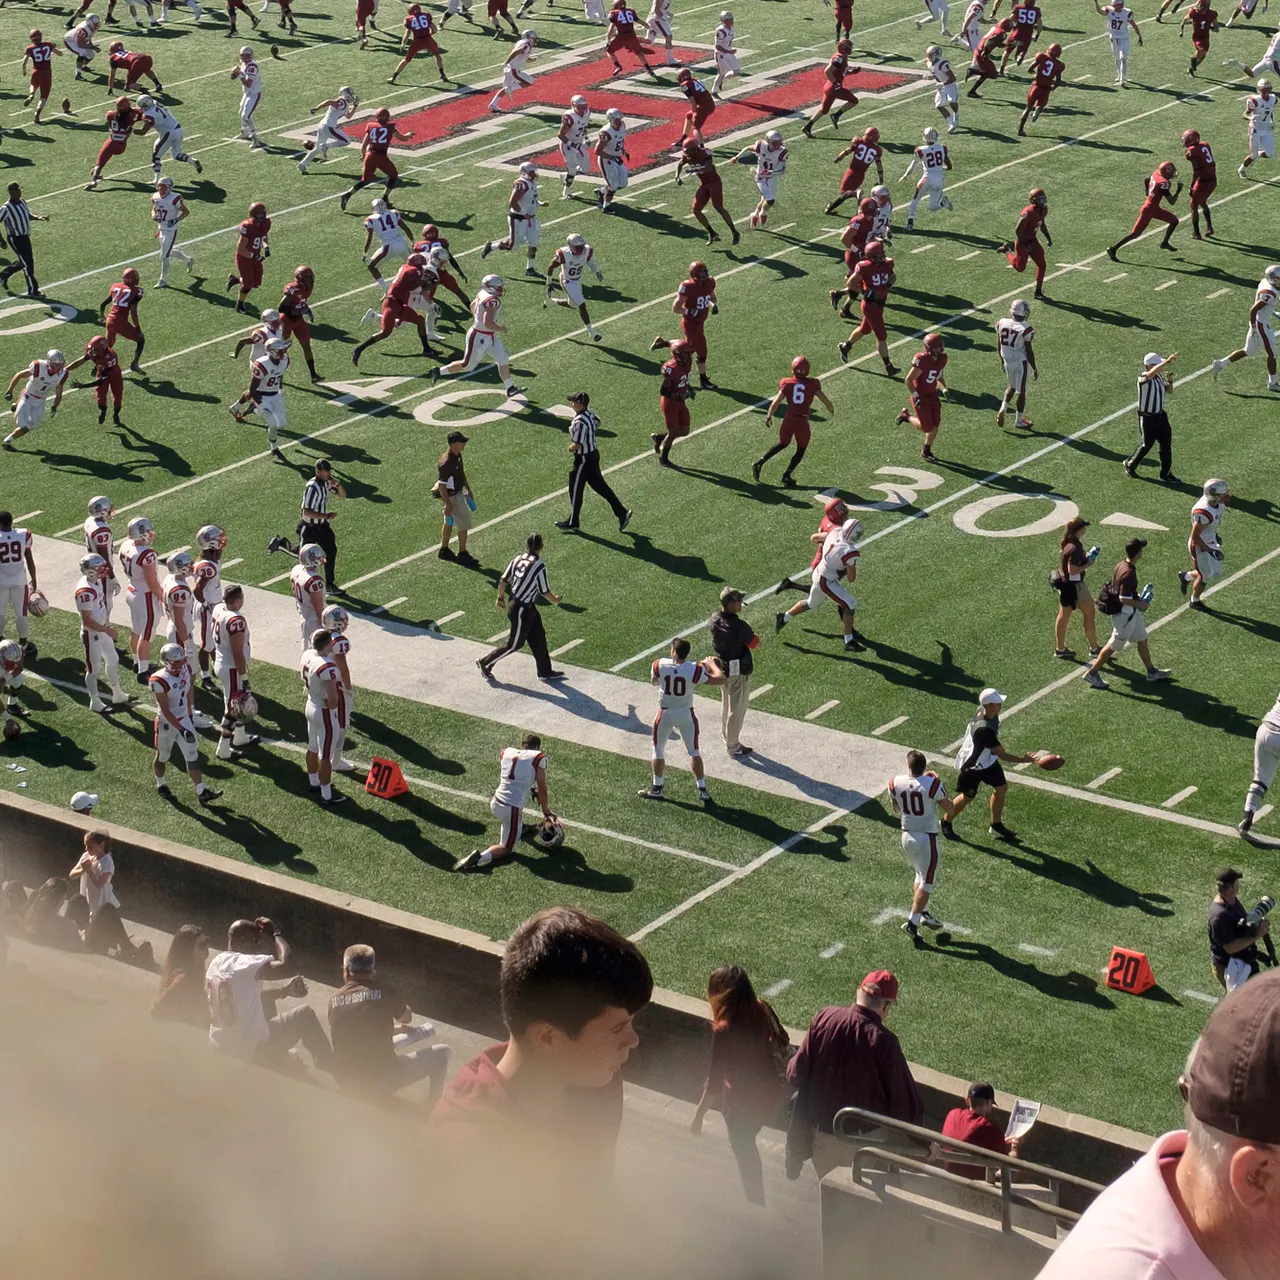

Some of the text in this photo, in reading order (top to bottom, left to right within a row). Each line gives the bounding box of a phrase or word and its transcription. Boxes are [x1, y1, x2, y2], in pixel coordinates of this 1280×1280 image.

[411, 16, 429, 29] 46
[617, 11, 633, 23] 46
[1019, 10, 1037, 23] 59
[1111, 19, 1123, 30] 87
[32, 47, 49, 60] 52
[1042, 60, 1053, 76] 3
[369, 128, 388, 143] 42
[856, 144, 876, 163] 36
[927, 151, 943, 168] 28
[1202, 147, 1213, 161] 3
[378, 216, 396, 230] 14
[1000, 328, 1018, 346] 27
[792, 384, 804, 404] 6
[664, 675, 686, 696] 10
[366, 761, 392, 792] 30
[509, 760, 517, 780] 1
[901, 789, 925, 818] 10
[1109, 954, 1140, 985] 20
